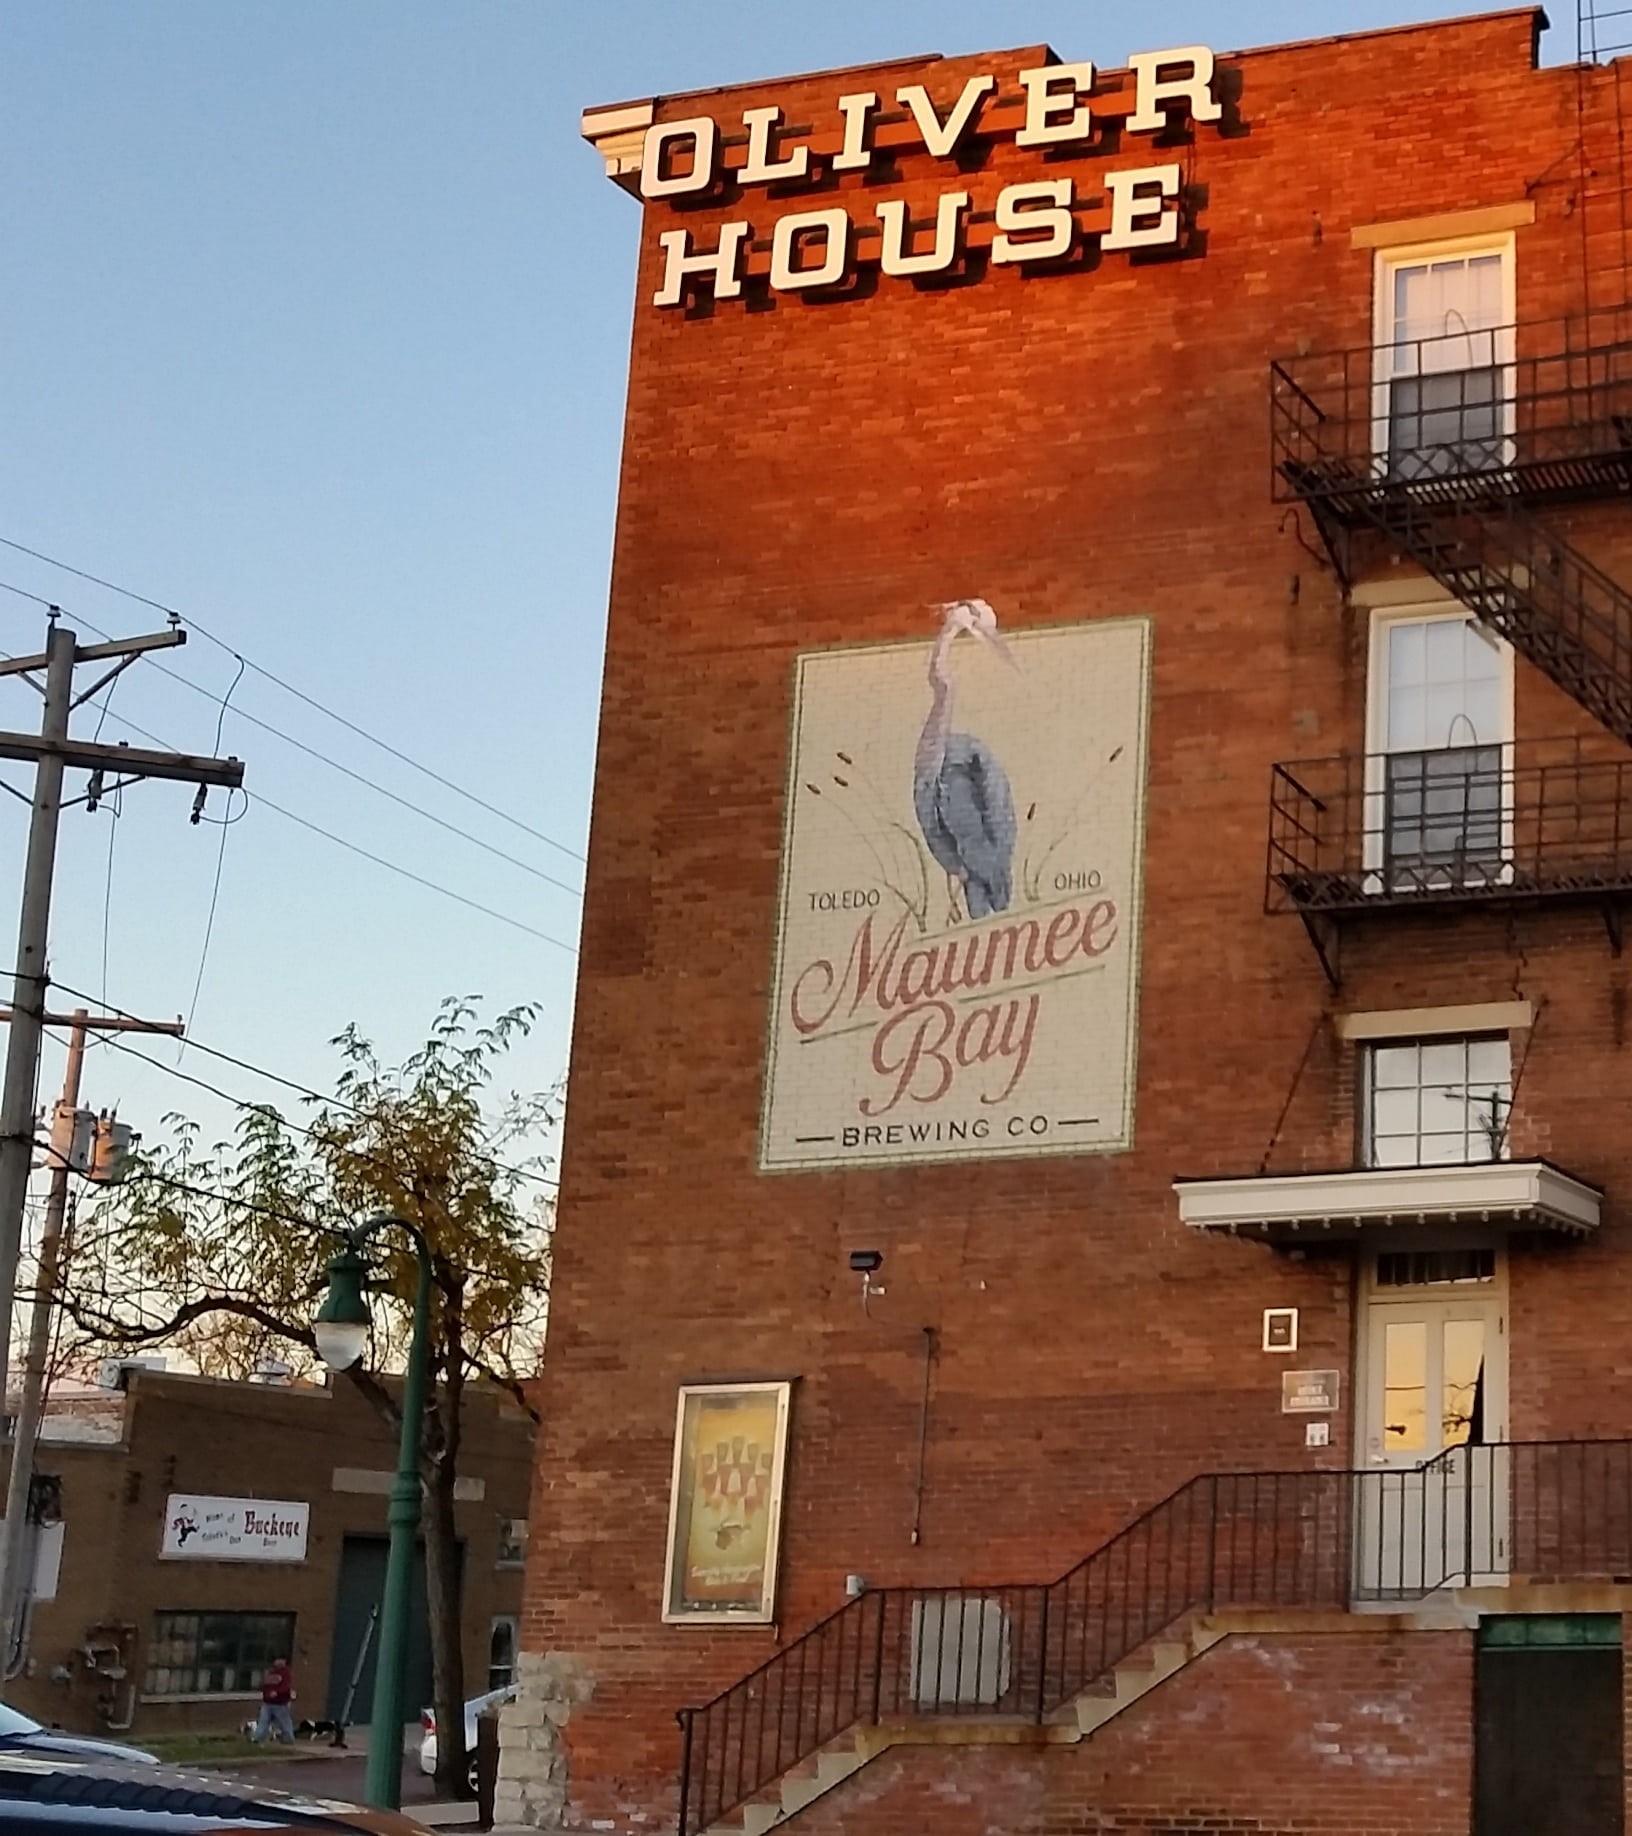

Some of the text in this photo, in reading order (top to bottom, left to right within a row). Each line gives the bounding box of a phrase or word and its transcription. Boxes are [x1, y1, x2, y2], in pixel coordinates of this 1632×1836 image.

[640, 45, 1222, 198] OLIVER
[653, 163, 1180, 307] HOUSE
[808, 889, 880, 912] TOLEDO
[1053, 869, 1102, 891] OHIO
[790, 899, 1118, 1035] Maumee
[858, 993, 1040, 1118] Bay
[841, 1115, 1049, 1148] BREWING CO
[244, 1510, 300, 1538] Buckeye
